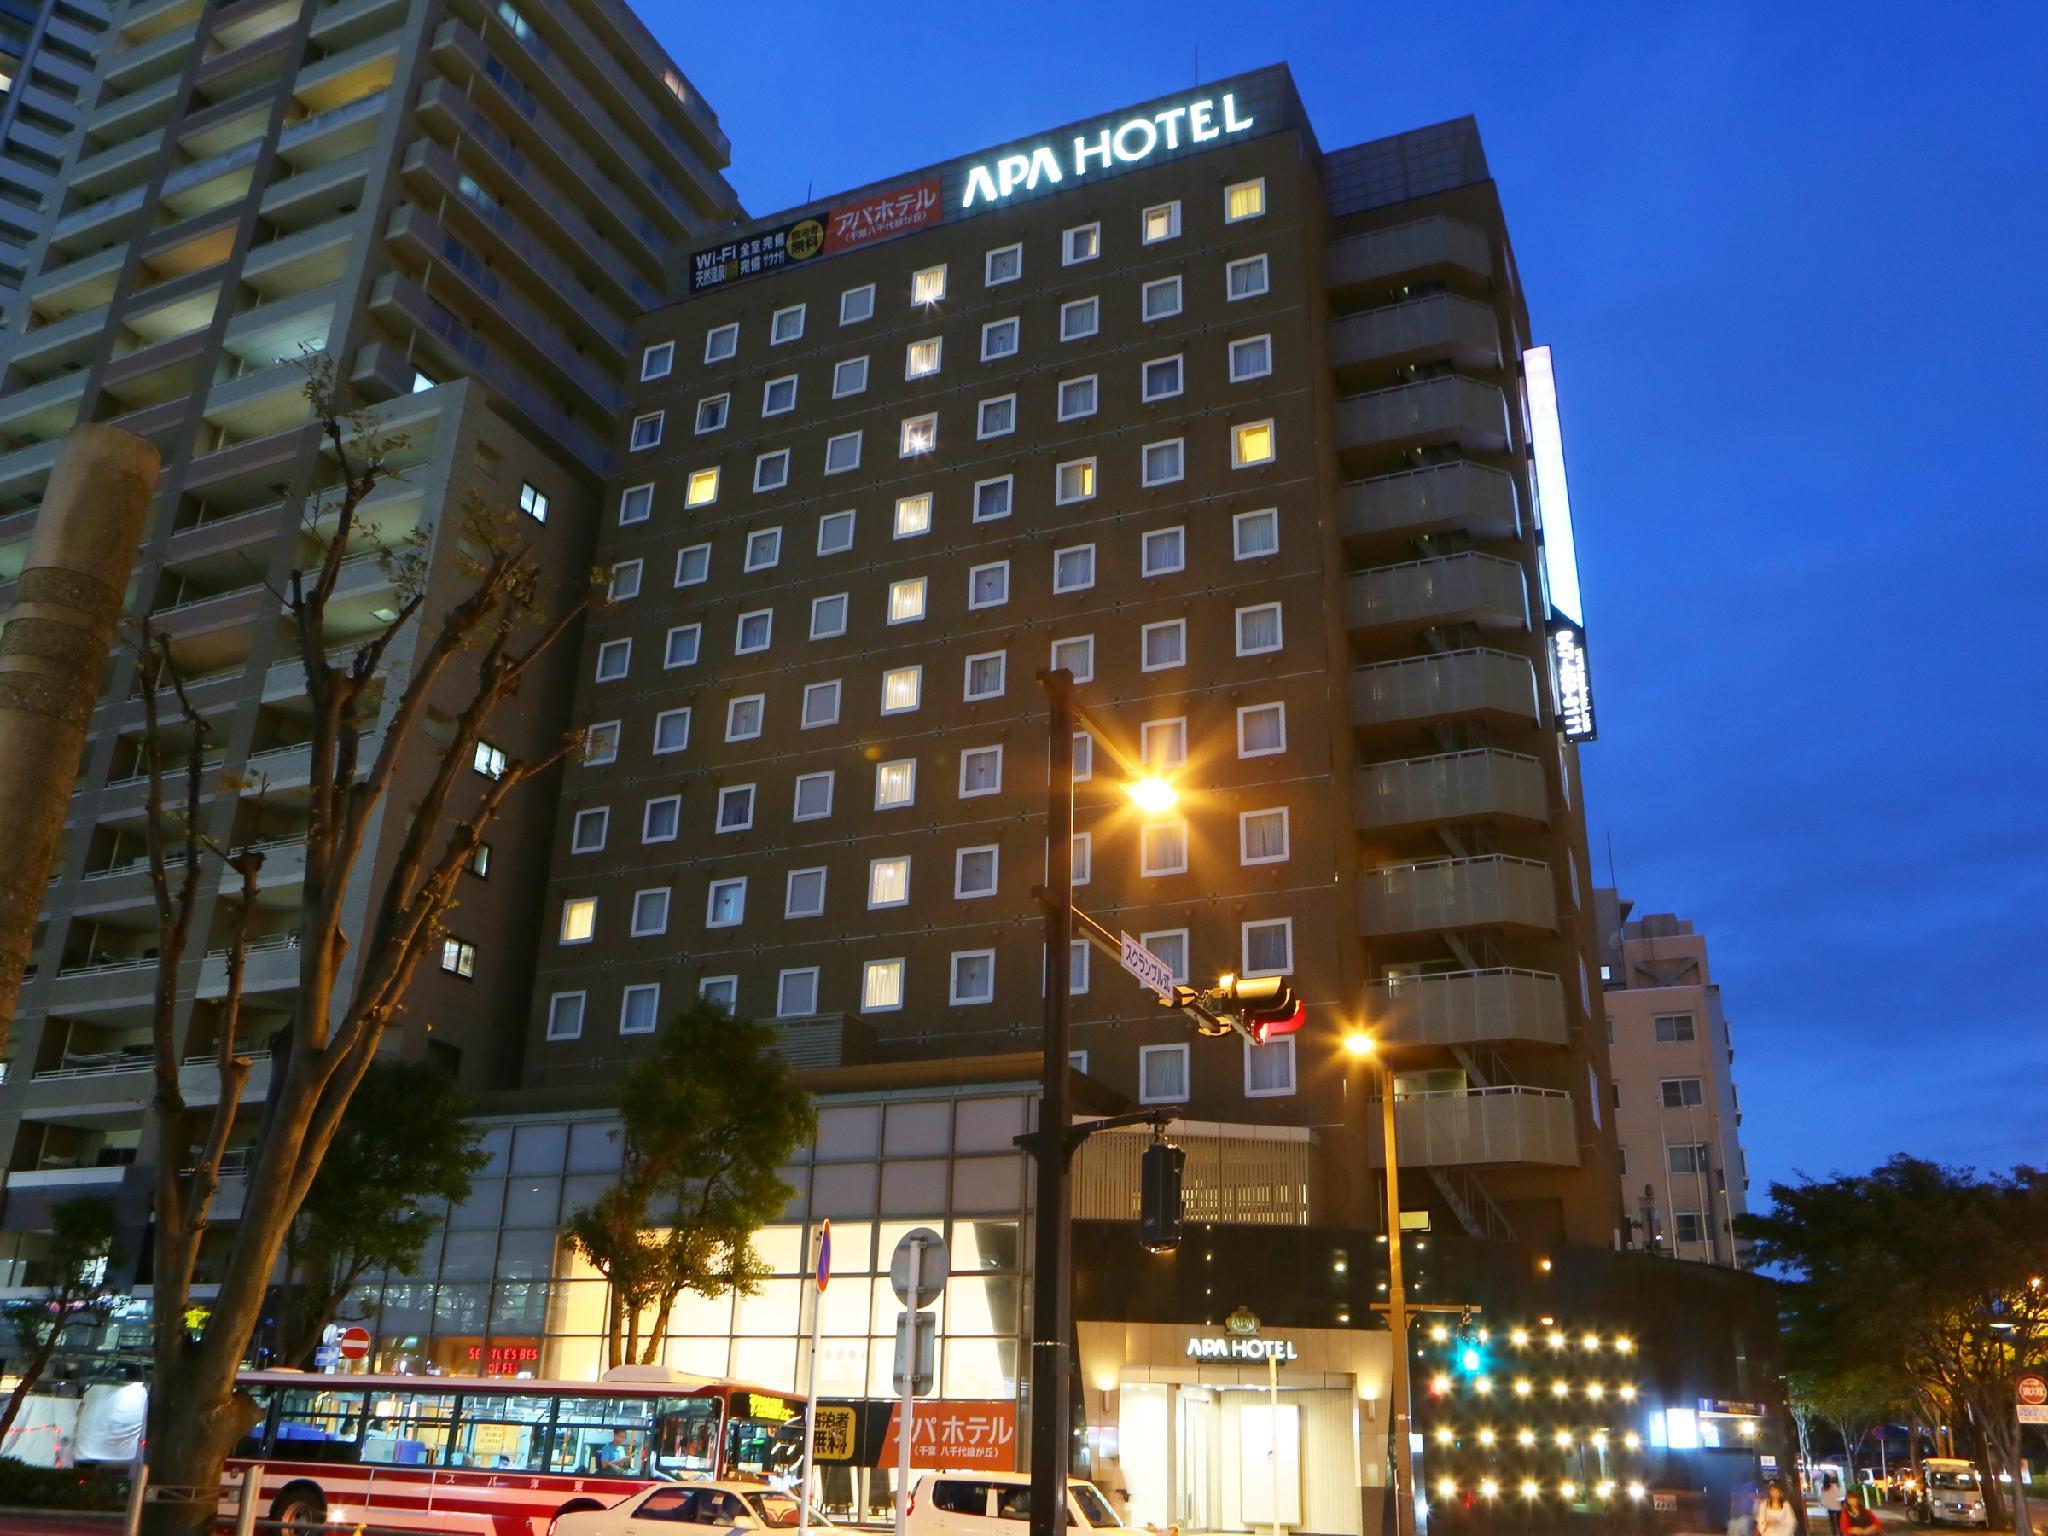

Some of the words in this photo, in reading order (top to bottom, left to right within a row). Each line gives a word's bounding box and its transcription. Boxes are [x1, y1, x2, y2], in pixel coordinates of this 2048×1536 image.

[962, 147, 1063, 208] APA
[1074, 93, 1254, 176] HOTEL
[835, 188, 937, 236] アパホテル
[695, 245, 737, 269] Wi-Fi
[519, 1348, 539, 1360] BES
[1187, 1338, 1229, 1357] APA
[1231, 1339, 1298, 1360] HOTEL
